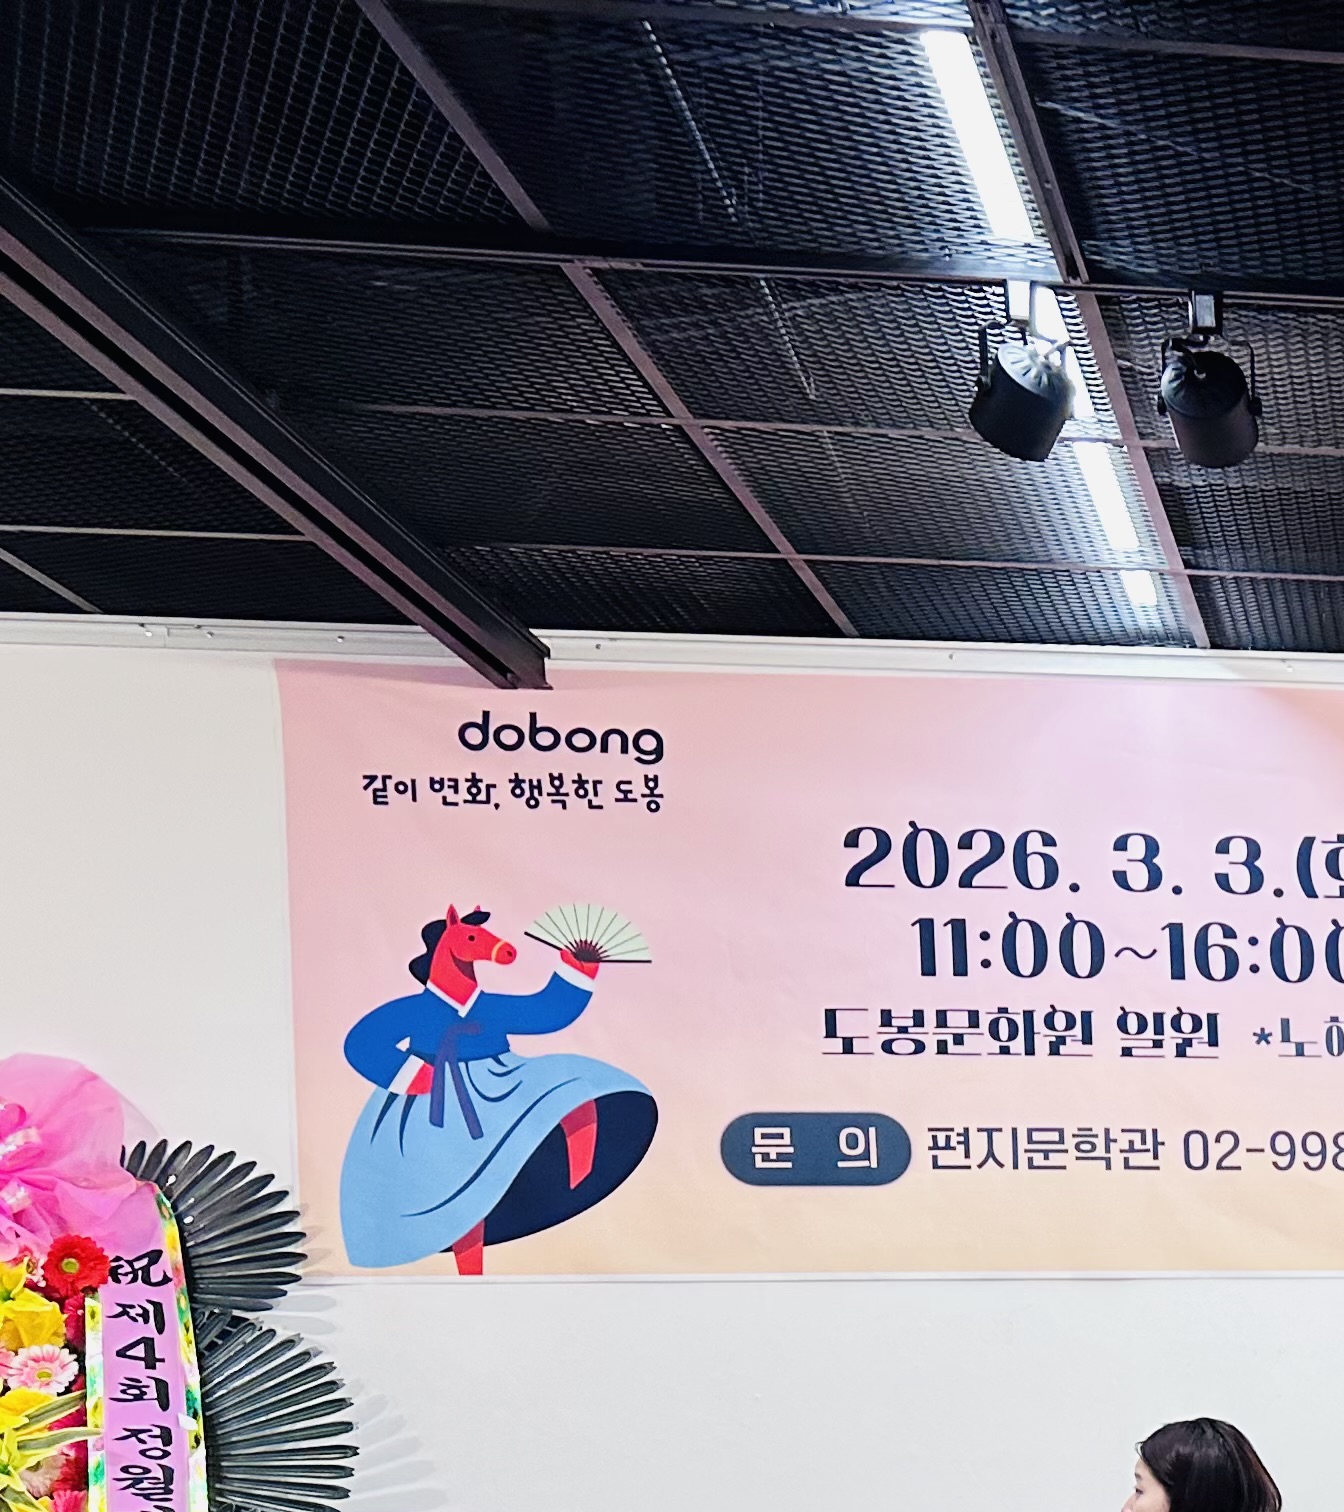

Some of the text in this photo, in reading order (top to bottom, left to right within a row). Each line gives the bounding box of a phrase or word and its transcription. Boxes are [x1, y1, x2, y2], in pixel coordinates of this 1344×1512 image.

[458, 710, 663, 765] dobong
[363, 772, 664, 813] 같이 변화, 행복한 도봉
[844, 821, 1080, 892] 2026.
[1112, 833, 1182, 895] 3.
[822, 1005, 1093, 1056] 도봉문화원
[1117, 1006, 1219, 1058] 일원
[928, 1127, 1165, 1170] 편지문학관
[107, 1249, 173, 1287] 祝
[105, 1298, 171, 1414] 제4회
